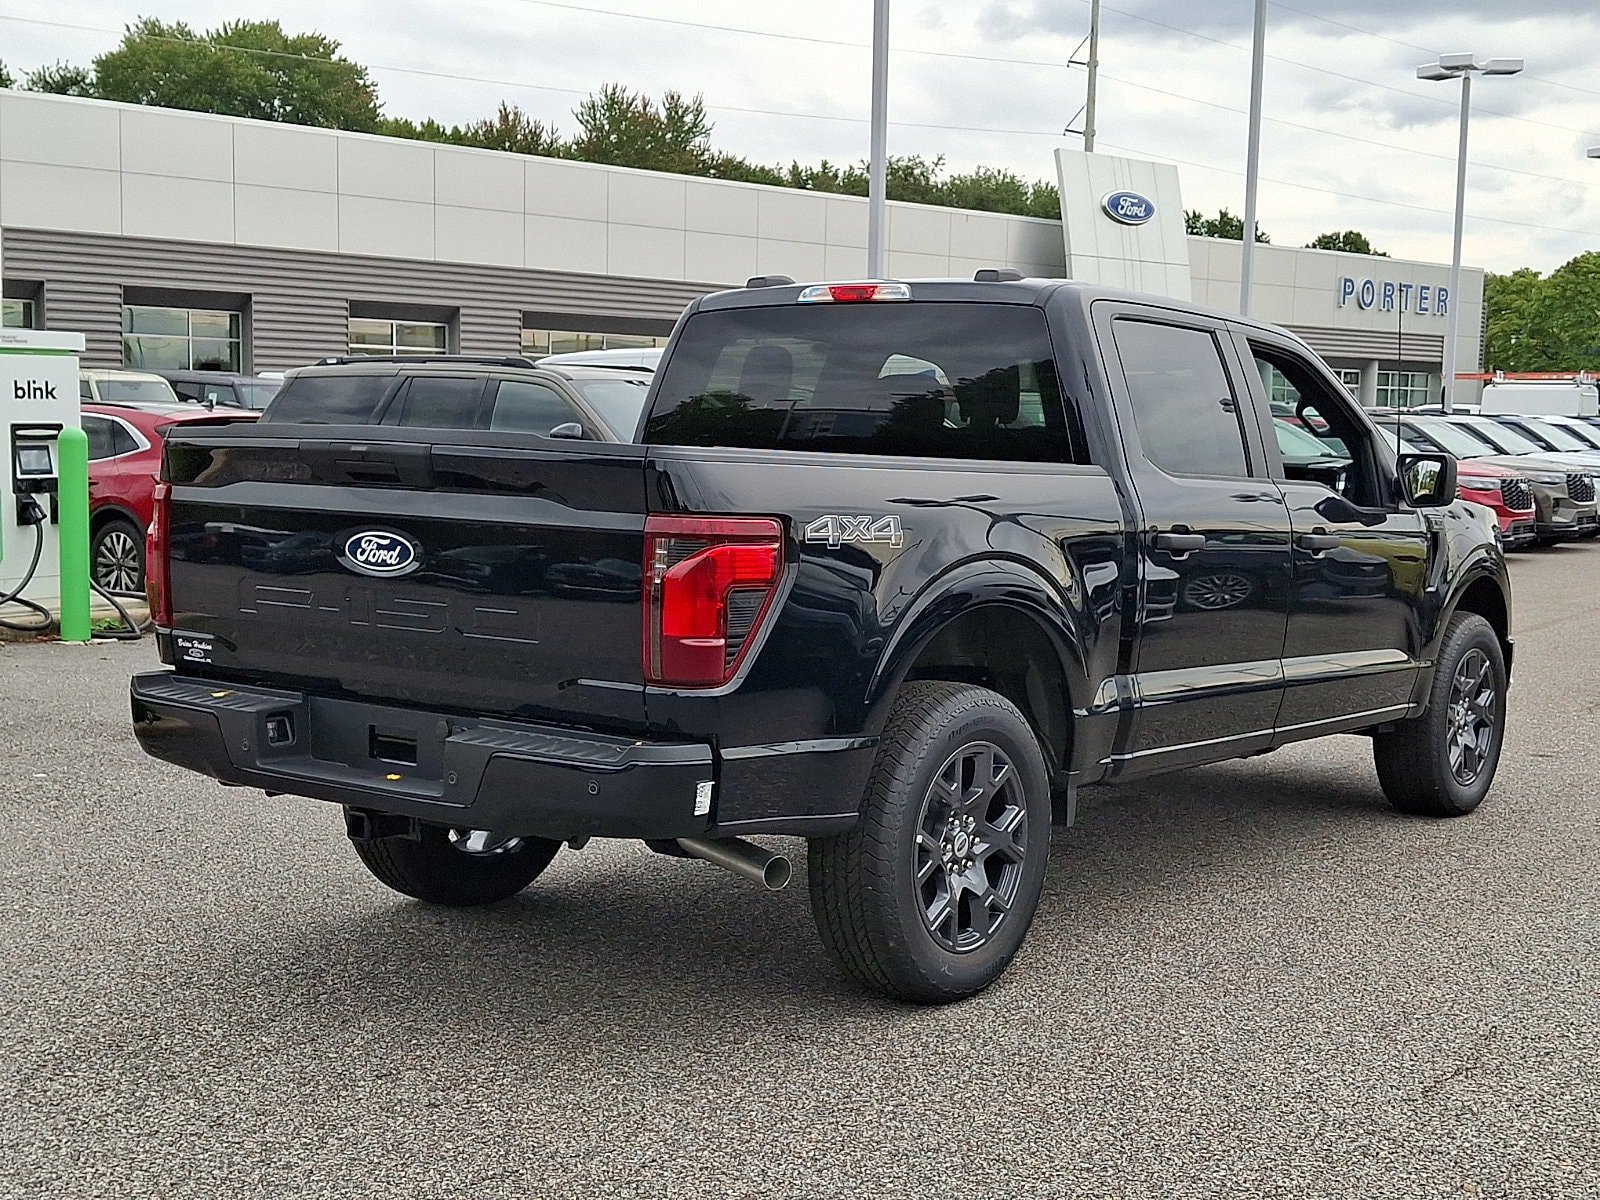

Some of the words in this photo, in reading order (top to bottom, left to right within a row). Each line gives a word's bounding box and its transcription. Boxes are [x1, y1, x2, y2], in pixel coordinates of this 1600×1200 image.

[1117, 196, 1146, 217] Ford
[1340, 276, 1450, 315] PORTER
[13, 379, 58, 400] blink
[356, 536, 402, 565] Ford
[239, 577, 544, 644] F-150
